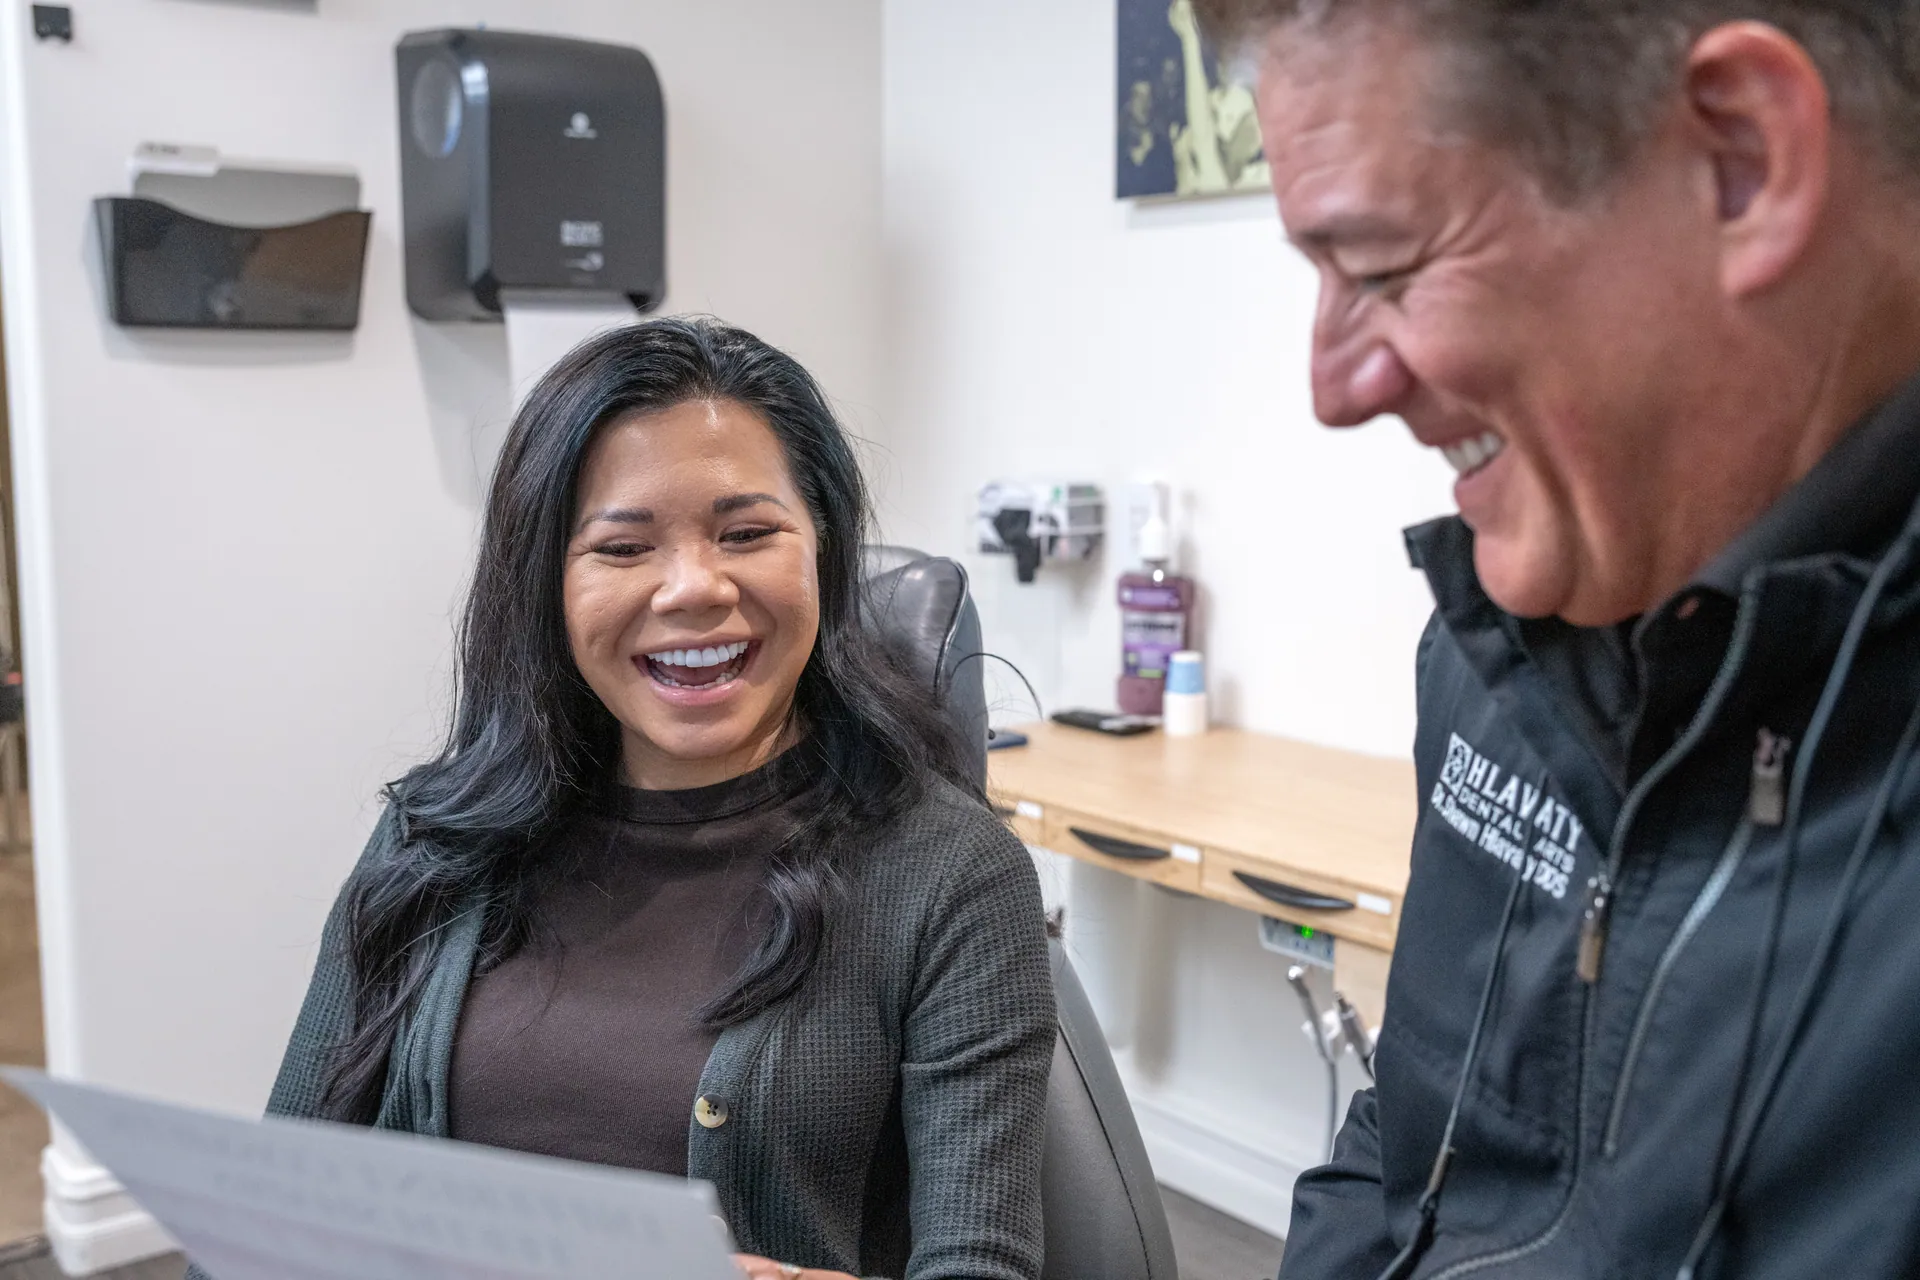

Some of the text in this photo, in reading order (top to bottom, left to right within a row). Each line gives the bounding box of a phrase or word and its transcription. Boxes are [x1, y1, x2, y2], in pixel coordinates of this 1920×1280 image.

[1458, 786, 1576, 874] DENTAL ARTS
[1466, 753, 1583, 852] HLAVATY
